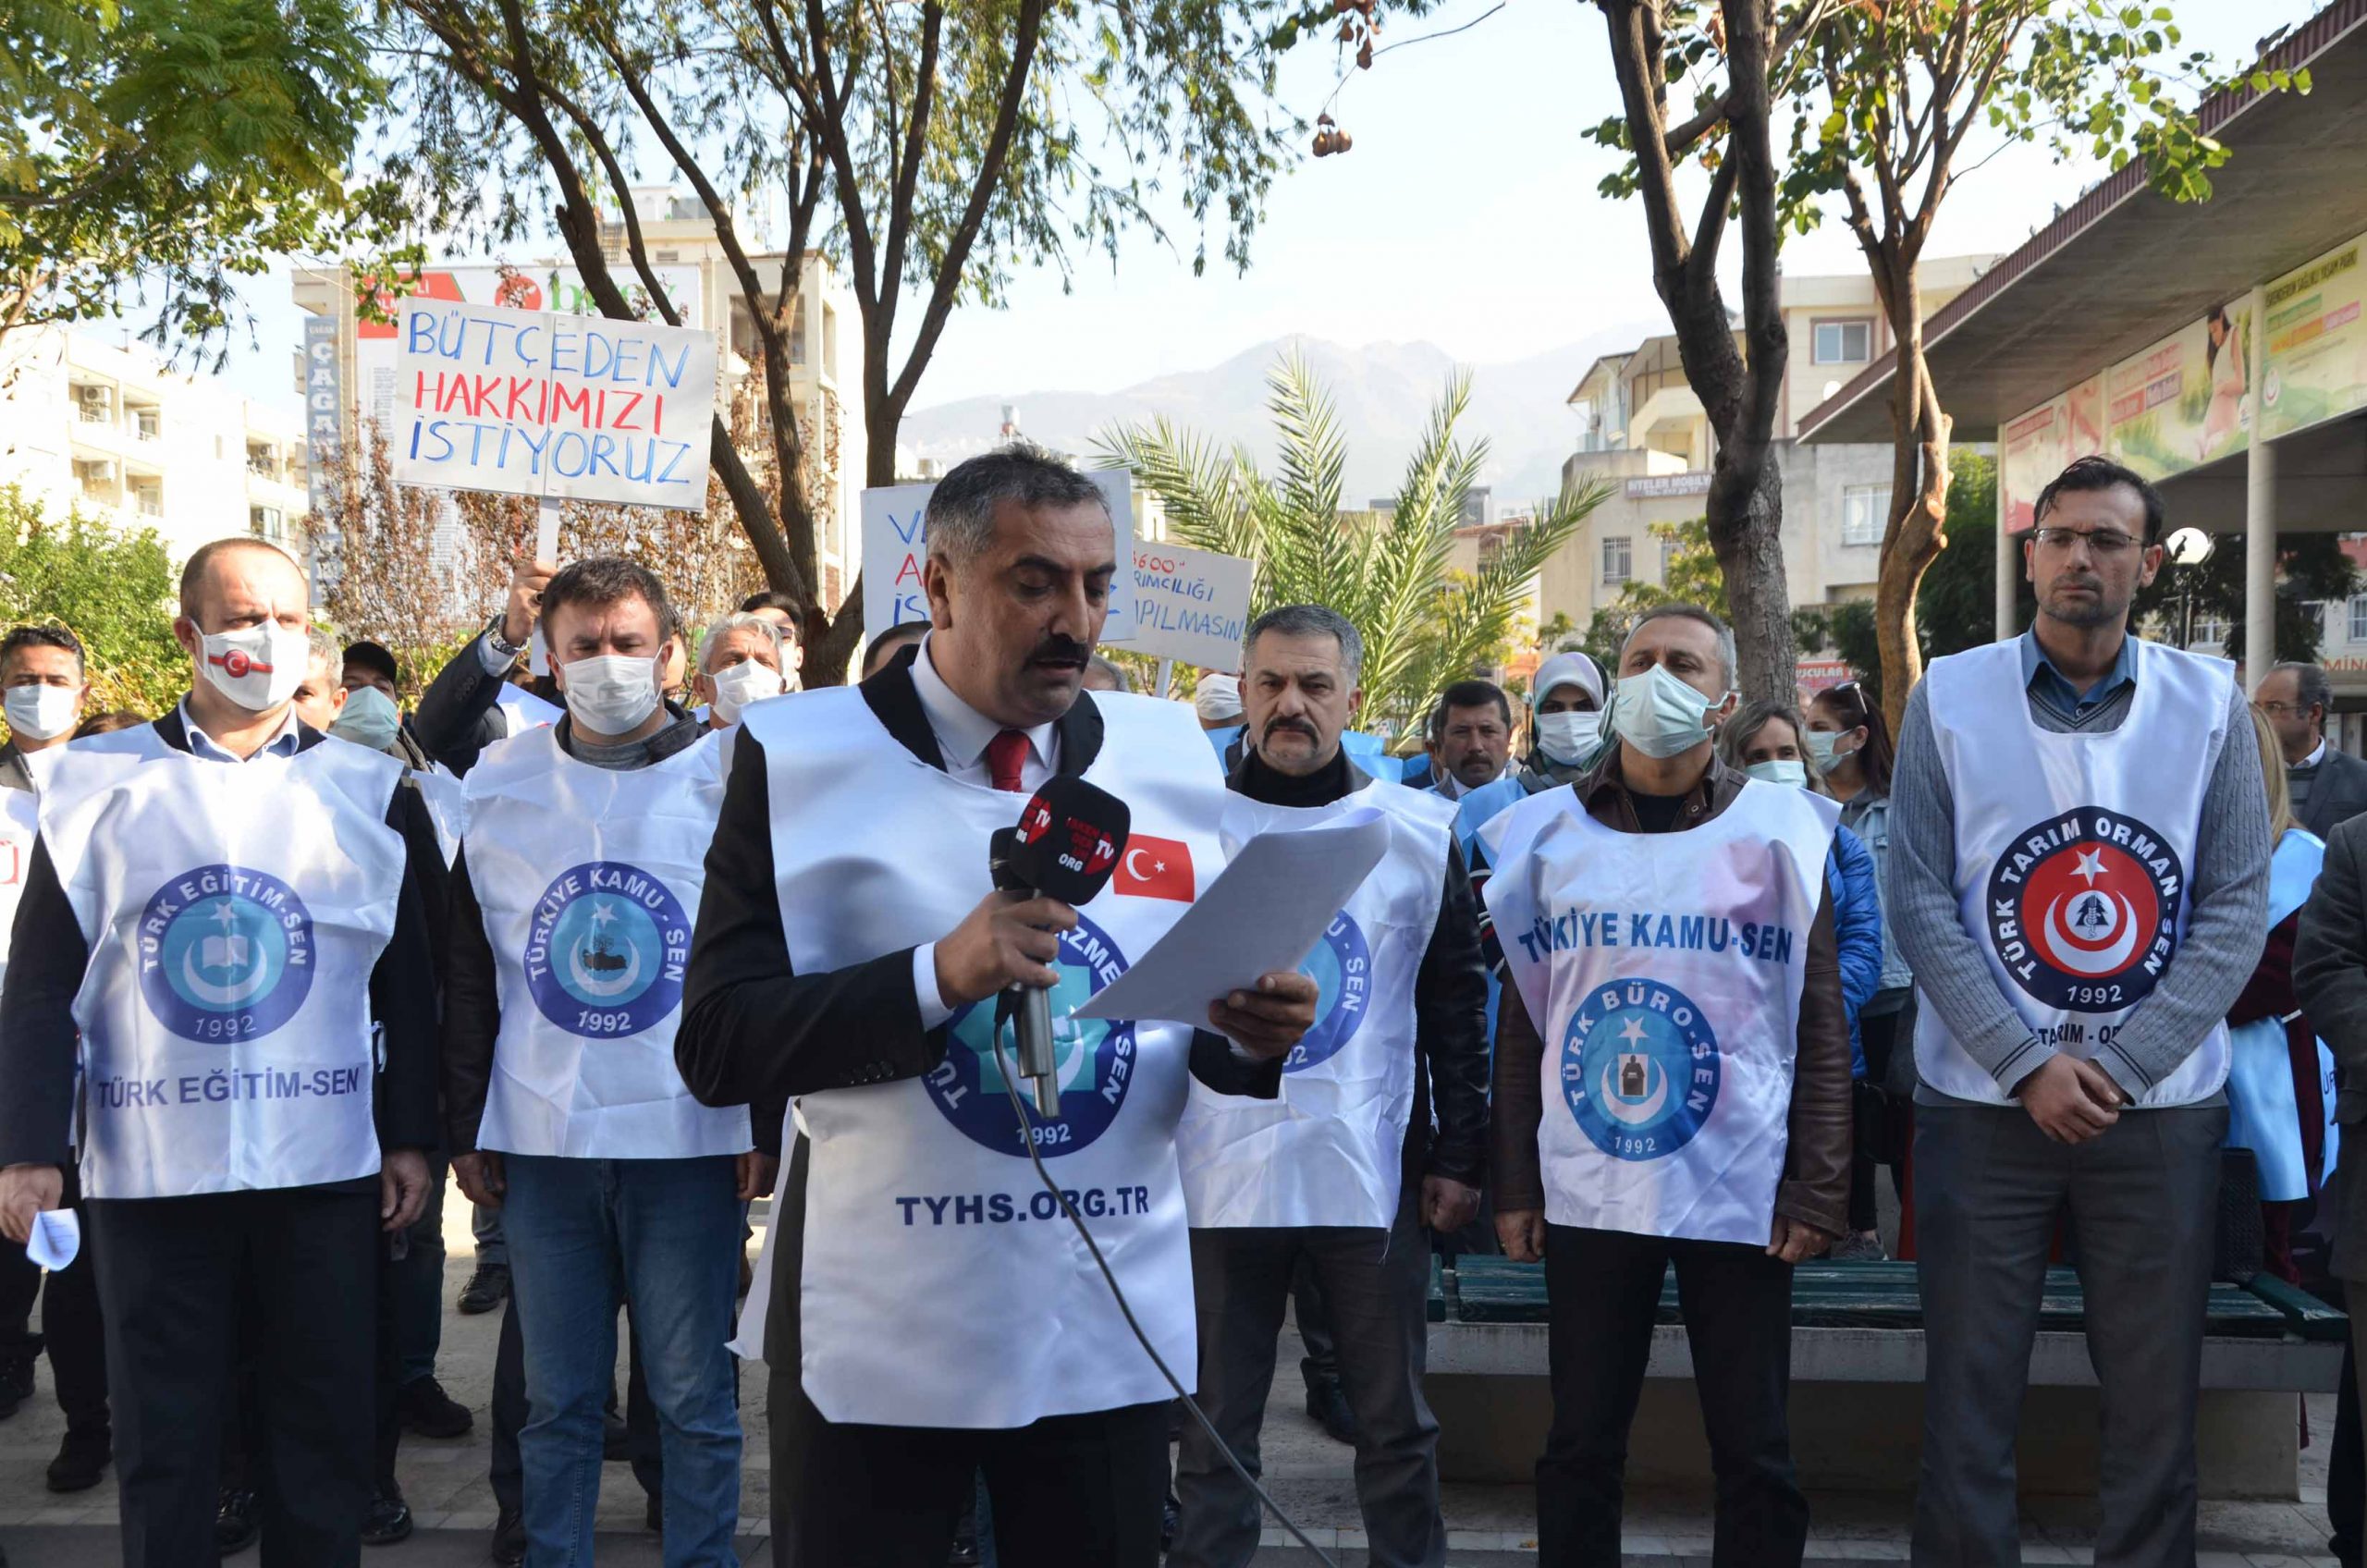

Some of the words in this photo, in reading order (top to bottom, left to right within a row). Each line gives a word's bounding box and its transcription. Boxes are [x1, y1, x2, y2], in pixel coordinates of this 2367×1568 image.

[409, 310, 690, 388] BÜTÇEDEN
[415, 371, 664, 435] HAKKIMIZI
[410, 415, 692, 484] İSTİYORUZ
[1134, 550, 1185, 573] 600"
[1134, 570, 1214, 601] RIMCILIĞI
[1135, 600, 1244, 642] PILMASIN
[1036, 809, 1050, 827] TV
[1058, 853, 1083, 872] ORG
[1096, 839, 1114, 859] TV
[2000, 817, 2081, 885] TARIM
[140, 898, 178, 973] TÜRK
[525, 875, 583, 982] TÜRKİYE
[1631, 912, 1793, 964] KAMU-SEN
[1995, 898, 2037, 981] TÜRK
[2067, 985, 2123, 1004] 1992
[194, 1014, 257, 1038] 1992
[578, 1011, 632, 1032] 1992
[2038, 1023, 2084, 1047] TARIM
[1563, 1011, 1595, 1107] TÜRK
[97, 1076, 168, 1109] TÜRK
[178, 1067, 359, 1104] EĞİTİM-SEN
[1017, 1124, 1072, 1145] 1992
[1614, 1136, 1657, 1155] 1992
[895, 1185, 1149, 1226] TYHS.ORG.TR
